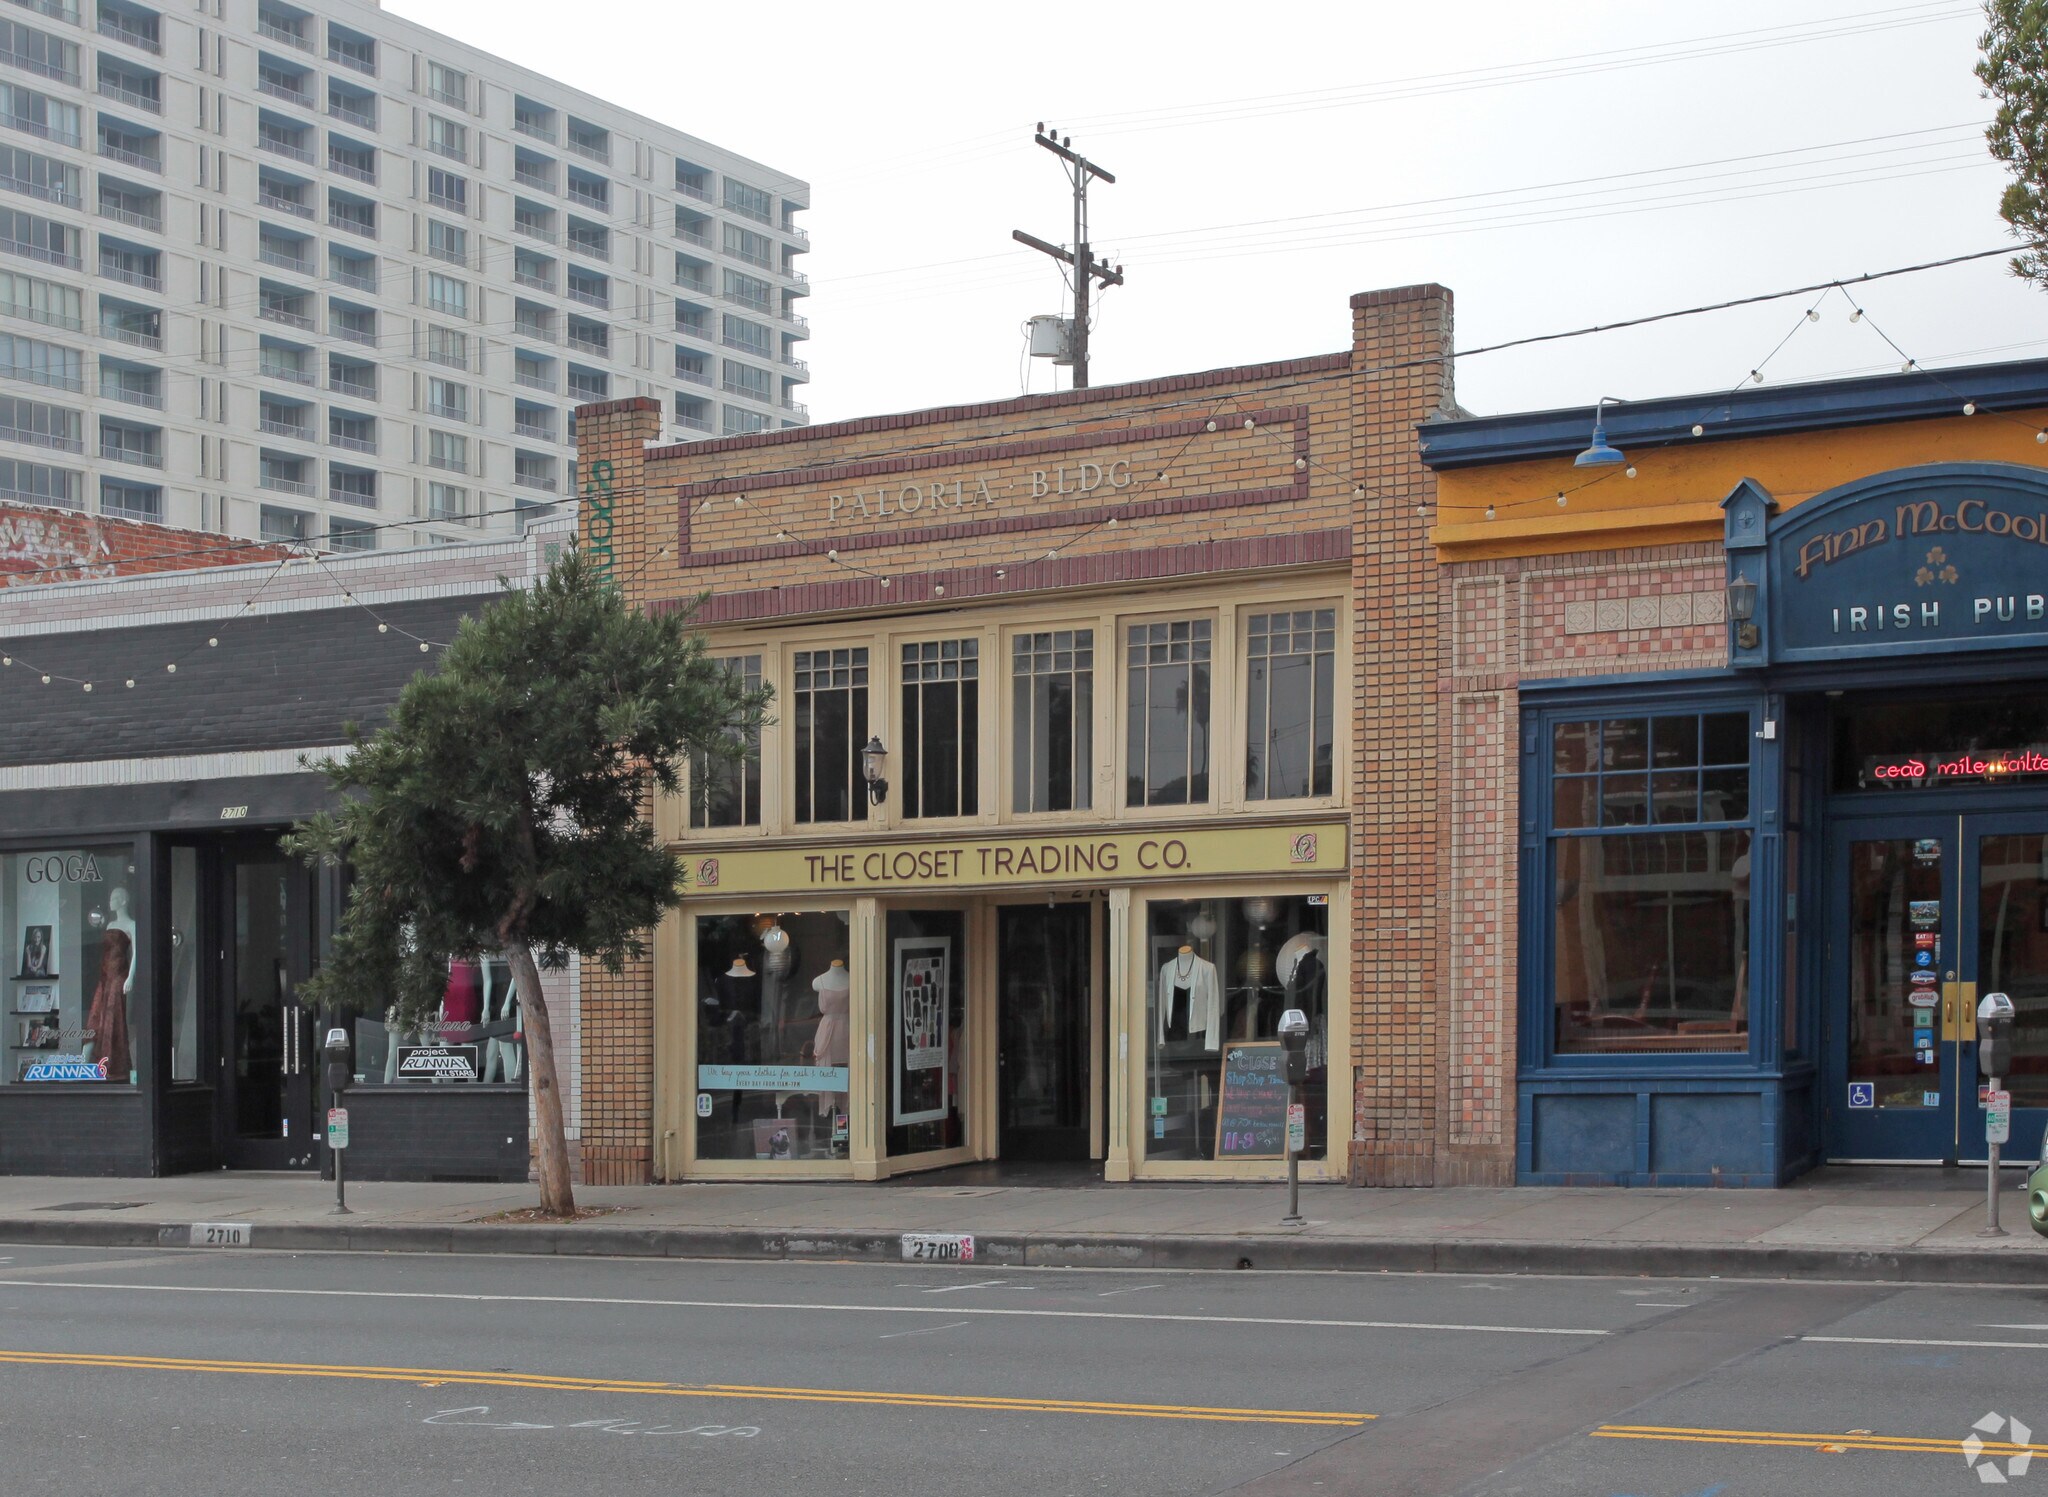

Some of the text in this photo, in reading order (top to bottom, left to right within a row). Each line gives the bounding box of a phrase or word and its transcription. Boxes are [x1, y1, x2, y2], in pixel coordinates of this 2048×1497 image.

[829, 459, 1138, 523] PALORIA BLDG.
[1794, 517, 1886, 577] Finn
[1832, 594, 2045, 633] IRISH PUB
[222, 807, 246, 818] 2710
[26, 853, 102, 884] GOGA
[804, 839, 1191, 883] THE CLOSET TRADING CO.
[46, 1053, 86, 1065] project
[411, 1048, 449, 1057] project
[402, 1058, 469, 1069] RUNWAY
[1238, 1055, 1280, 1070] CLOSE
[28, 1065, 98, 1079] RUNWAY
[207, 1228, 240, 1244] 2710
[913, 1241, 959, 1259] 2708
